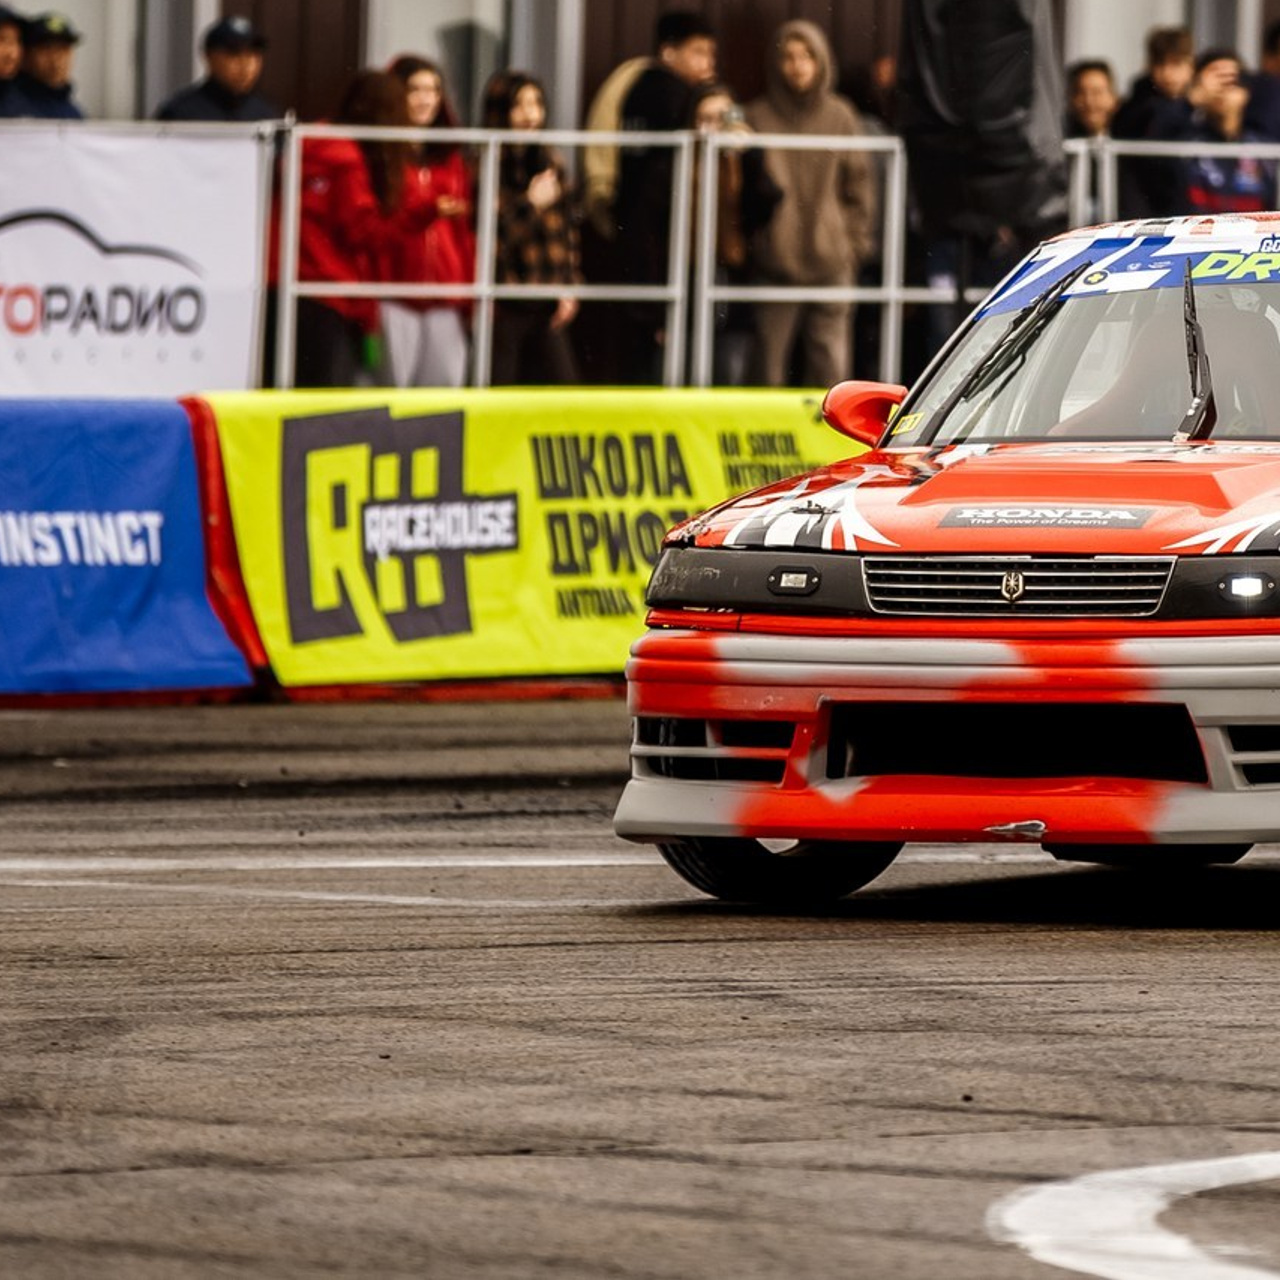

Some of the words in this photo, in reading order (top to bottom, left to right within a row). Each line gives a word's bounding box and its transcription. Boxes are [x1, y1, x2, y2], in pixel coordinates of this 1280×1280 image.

[0, 284, 206, 336] ОРАДИО
[529, 432, 693, 500] ШКОЛА
[0, 511, 164, 566] INSTINCT
[363, 500, 517, 561] RACEHOUSE
[956, 508, 1137, 520] HONDA
[1057, 518, 1109, 526] Dreams
[546, 509, 706, 575] ДРИФ
